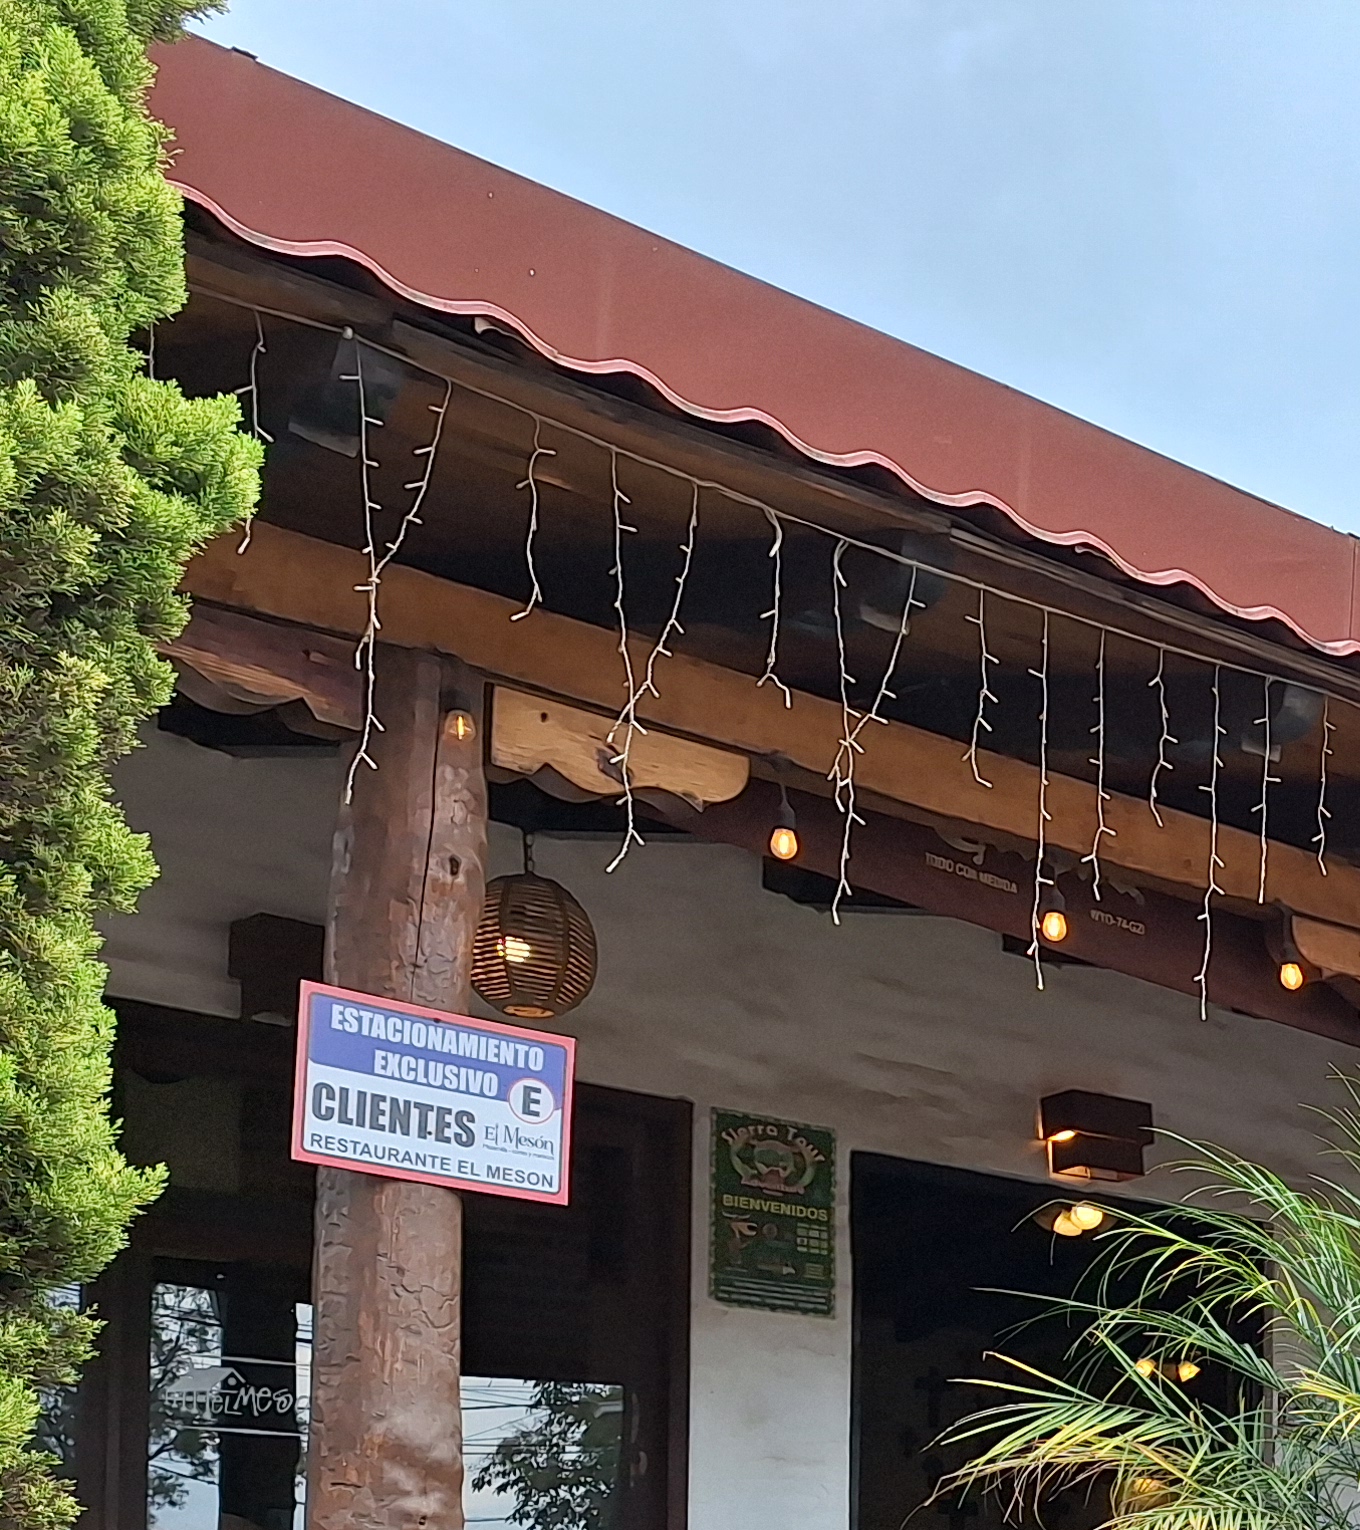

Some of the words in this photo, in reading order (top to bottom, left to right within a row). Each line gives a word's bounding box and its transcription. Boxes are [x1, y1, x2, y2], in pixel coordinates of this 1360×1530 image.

[331, 1004, 544, 1071] ESTACIONAMIENTO
[373, 1049, 498, 1097] EXCLUSIVO
[522, 1085, 542, 1117] E
[312, 1082, 476, 1148] CLIENTES
[484, 1123, 498, 1145] El
[504, 1125, 554, 1155] Mesón
[310, 1133, 452, 1172] RESTAURANTE
[457, 1159, 481, 1177] EL
[486, 1165, 553, 1188] MESON
[722, 1194, 828, 1221] BIENVENIDOS
